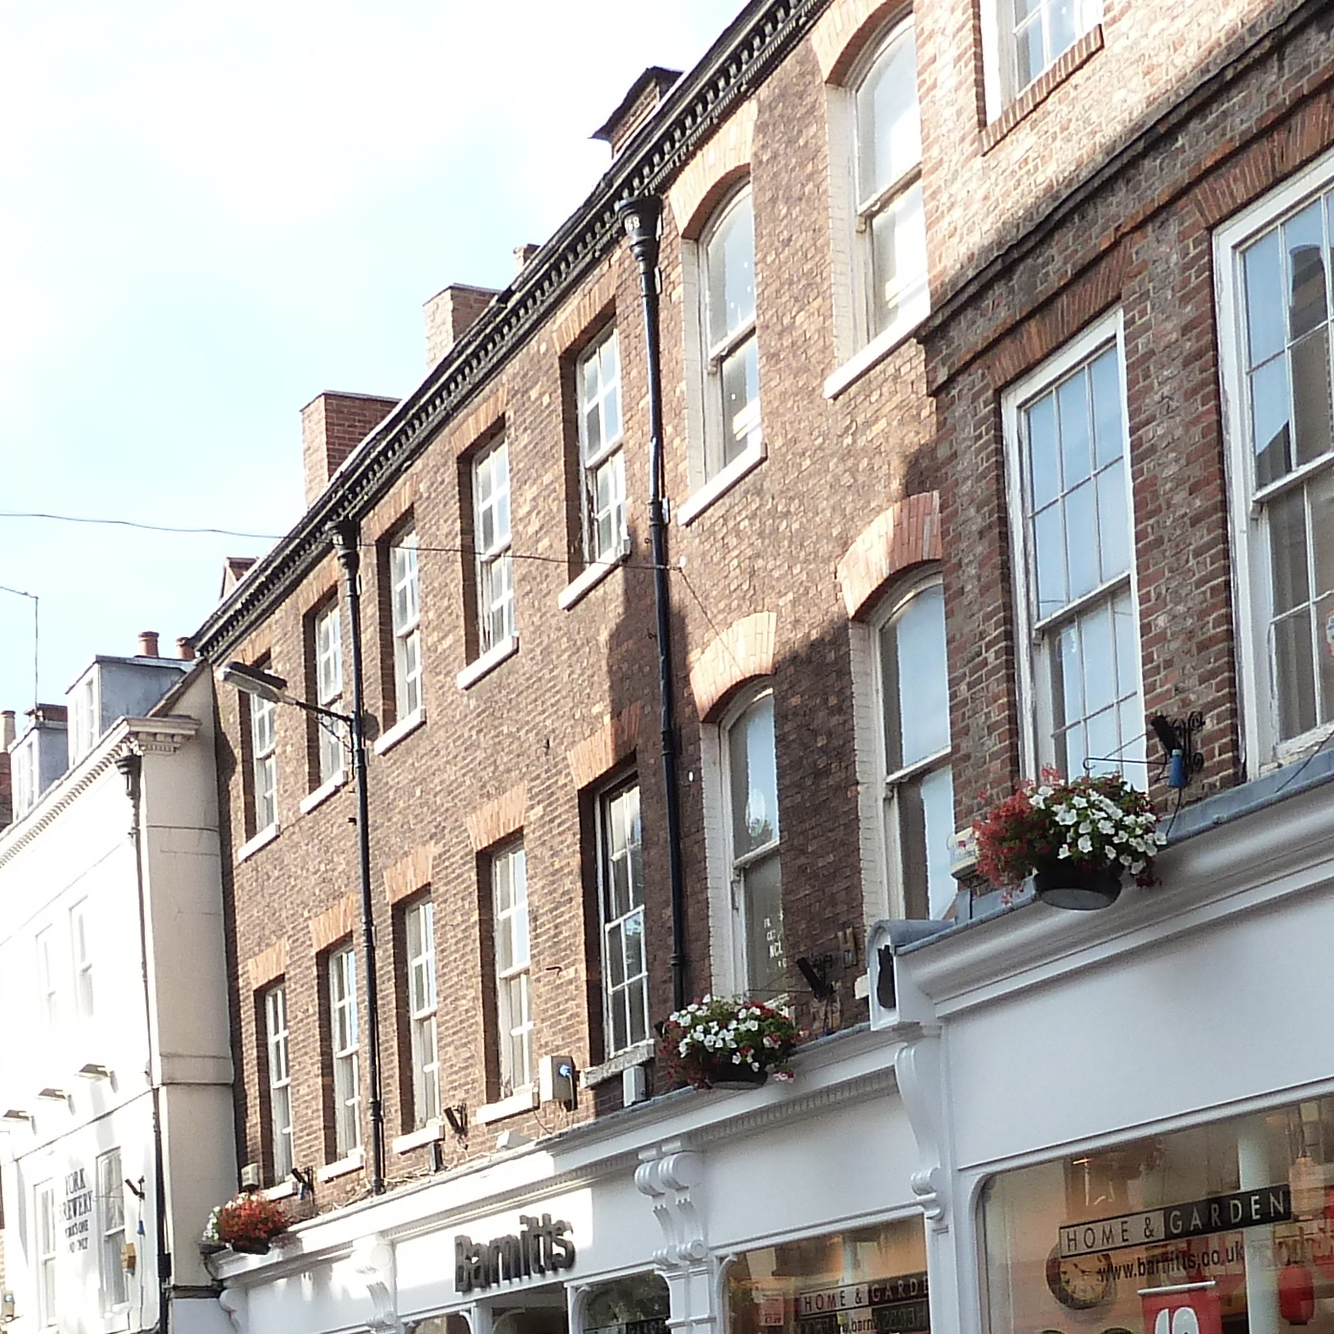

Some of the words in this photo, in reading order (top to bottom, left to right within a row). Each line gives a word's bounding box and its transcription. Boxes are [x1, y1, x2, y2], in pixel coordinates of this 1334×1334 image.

[1067, 1221, 1129, 1251] HOME
[1143, 1216, 1156, 1239] &
[1170, 1194, 1286, 1234] GARDEN
[454, 1213, 575, 1293] Barnitts
[805, 1291, 846, 1315] HOME
[855, 1288, 863, 1304] &
